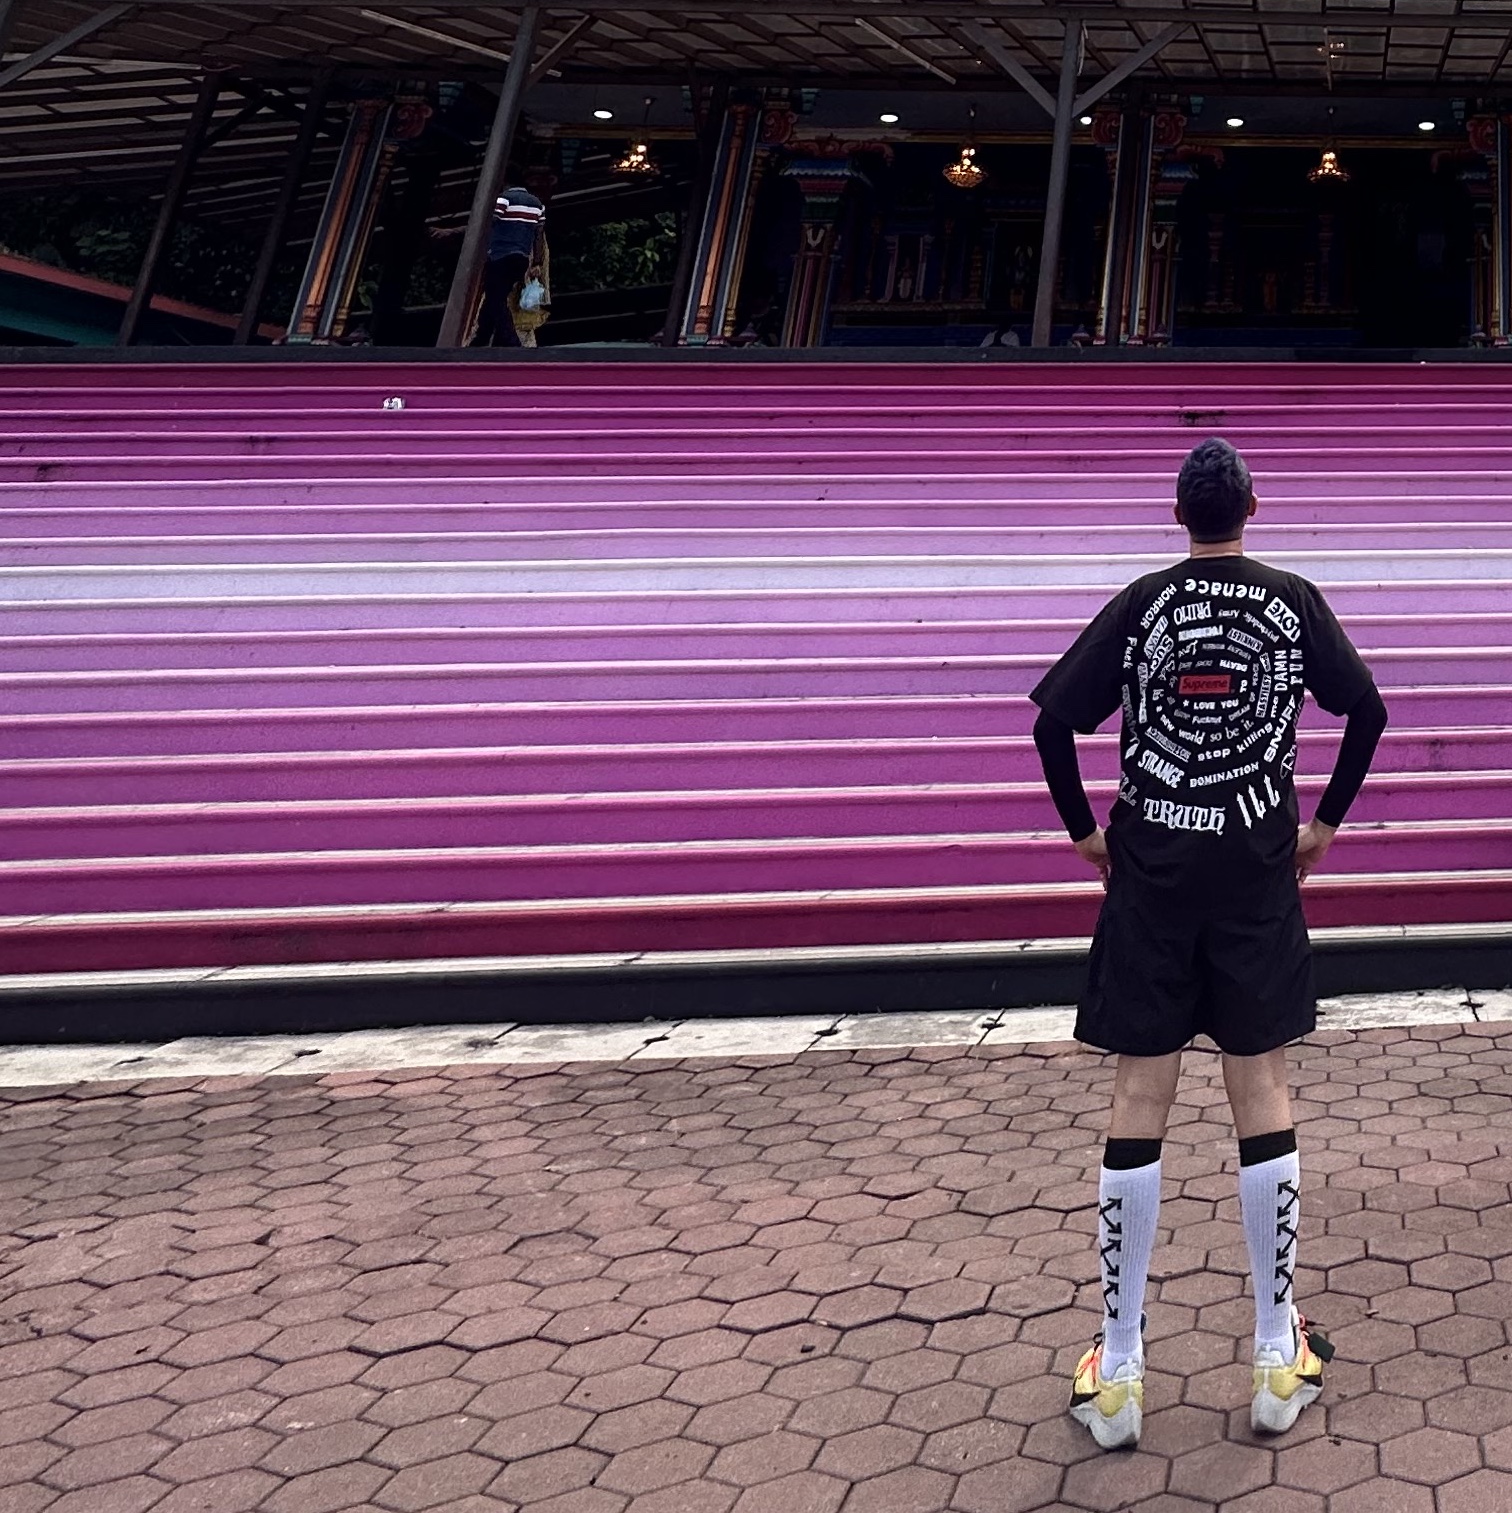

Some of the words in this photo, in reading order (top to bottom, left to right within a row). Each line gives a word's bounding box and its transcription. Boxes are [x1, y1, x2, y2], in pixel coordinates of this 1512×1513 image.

[1185, 578, 1266, 601] menace
[1140, 583, 1177, 629] HORROR
[1274, 649, 1288, 692] DAMN
[1193, 701, 1216, 710] LOVE
[1220, 698, 1239, 709] YOU
[1178, 728, 1206, 745] world
[1225, 726, 1240, 739] be
[1236, 722, 1273, 753] killing
[1189, 760, 1259, 788] DOMINATION
